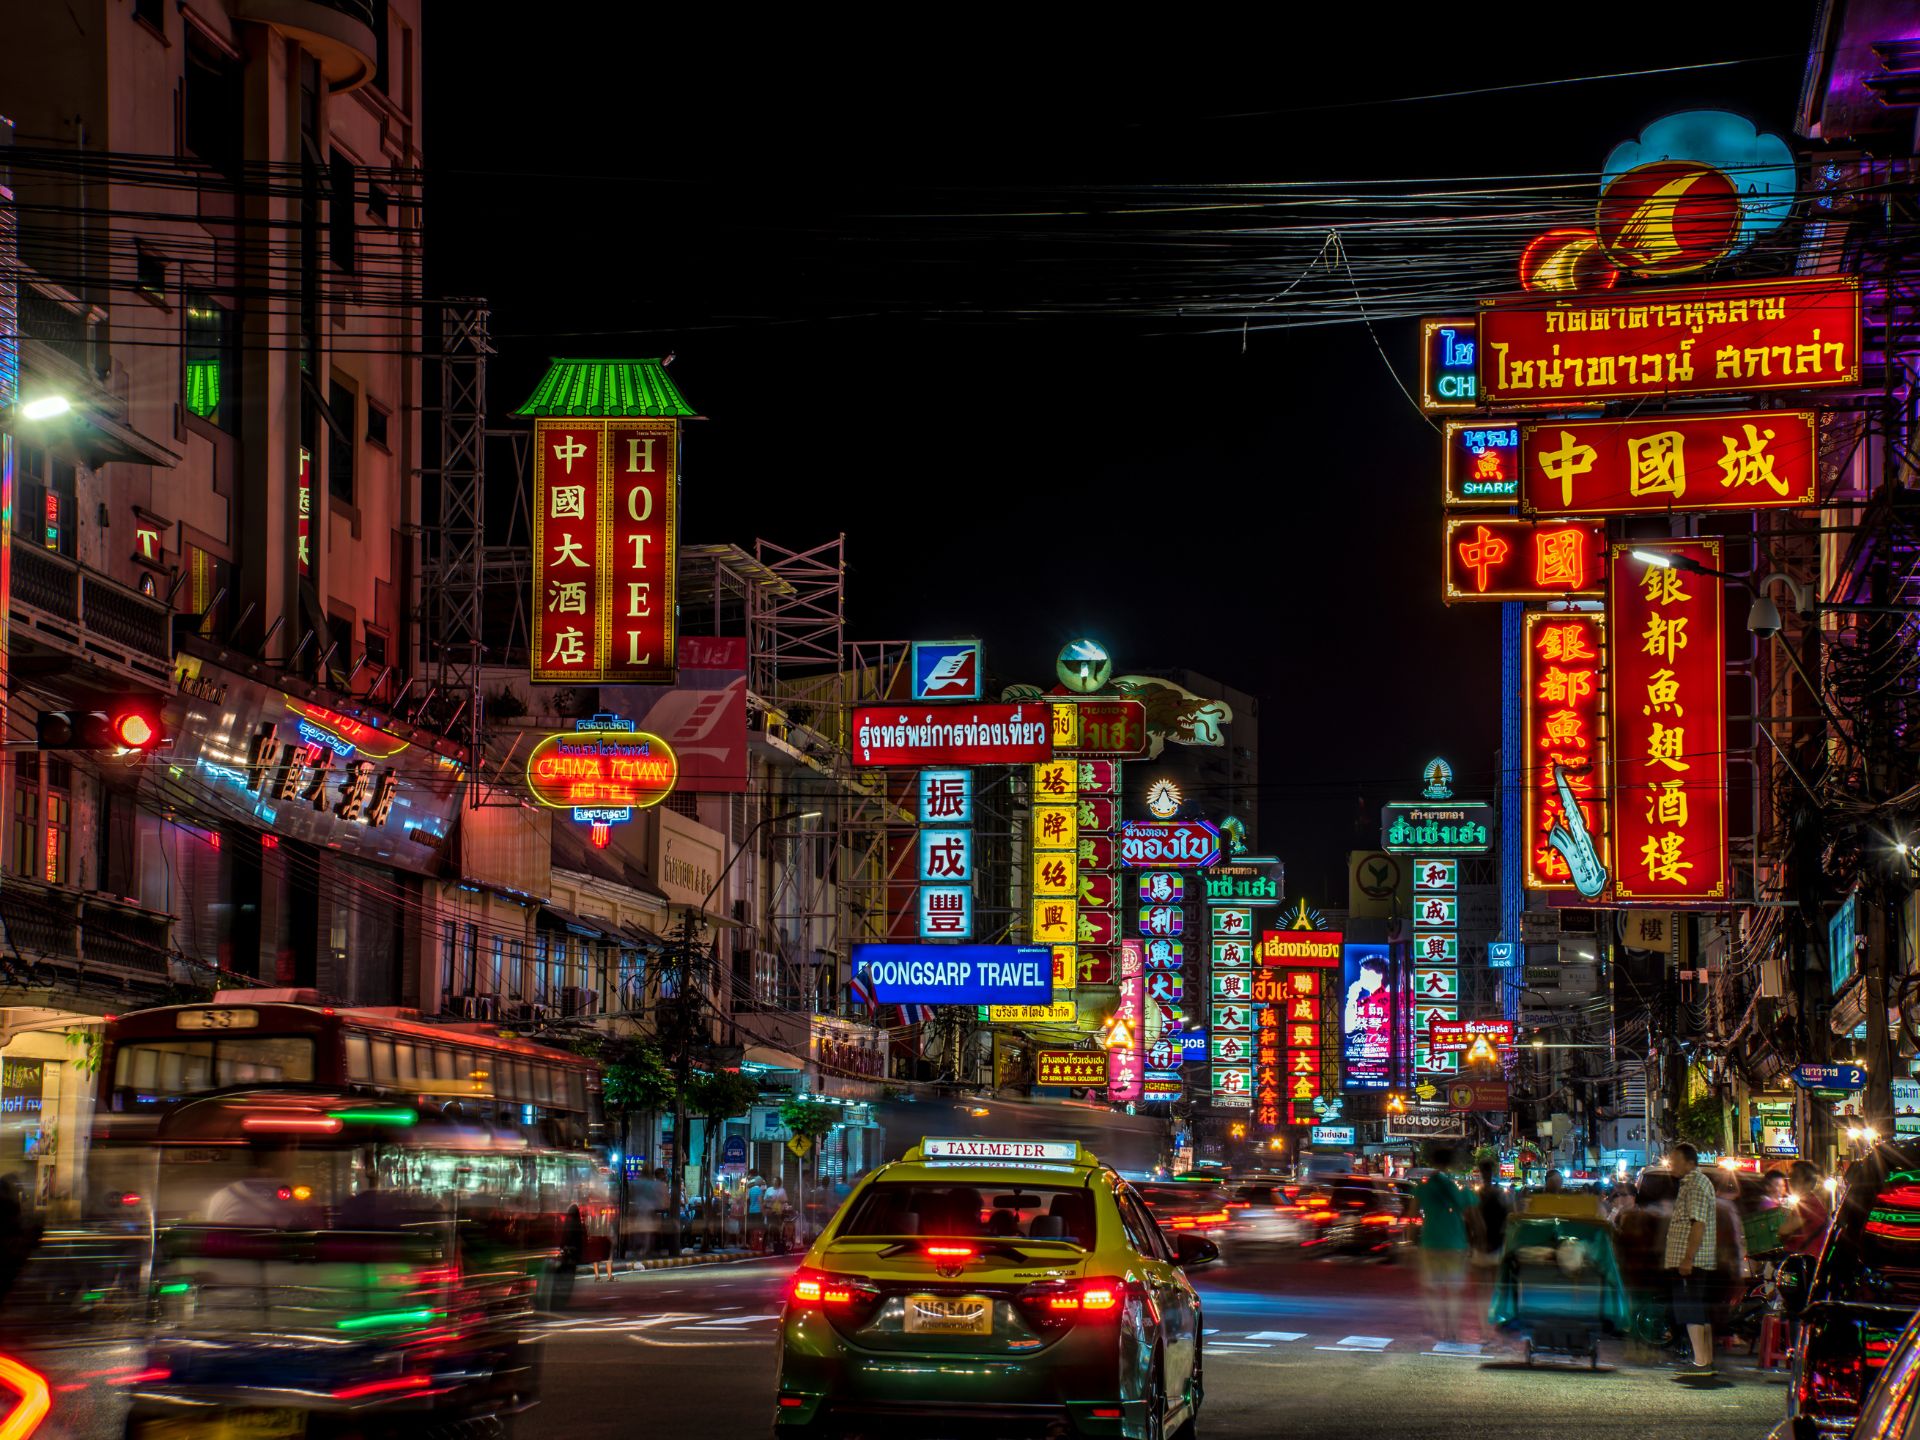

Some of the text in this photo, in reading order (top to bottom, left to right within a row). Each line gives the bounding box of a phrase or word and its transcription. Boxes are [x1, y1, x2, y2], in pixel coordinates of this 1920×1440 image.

[1490, 328, 1846, 390] ไชน่าทาวน์ สกาล่า
[1538, 424, 1789, 507] 中國城
[546, 434, 591, 665] 中國大酒店
[625, 438, 656, 665] HOTEL
[1458, 525, 1584, 592] 中國
[859, 706, 1046, 761] รุ่งทรัพย์การท่องเที่ยว
[1640, 560, 1694, 885] 銀都魚翅酒樓
[538, 758, 668, 781] CHINA TOWN
[927, 778, 965, 933] 振成豐
[1124, 824, 1169, 837] ห้างทอง
[977, 962, 1045, 987] TRAVEL
[1222, 912, 1243, 1090] 和成興大金行
[202, 1009, 234, 1029] 53
[1117, 978, 1135, 1089] 北京仁堂
[1294, 974, 1315, 1123] 聯成興大金
[1801, 1067, 1839, 1077] เยาวราช
[1850, 1070, 1860, 1083] 2
[946, 1141, 1045, 1157] TAXI-METER
